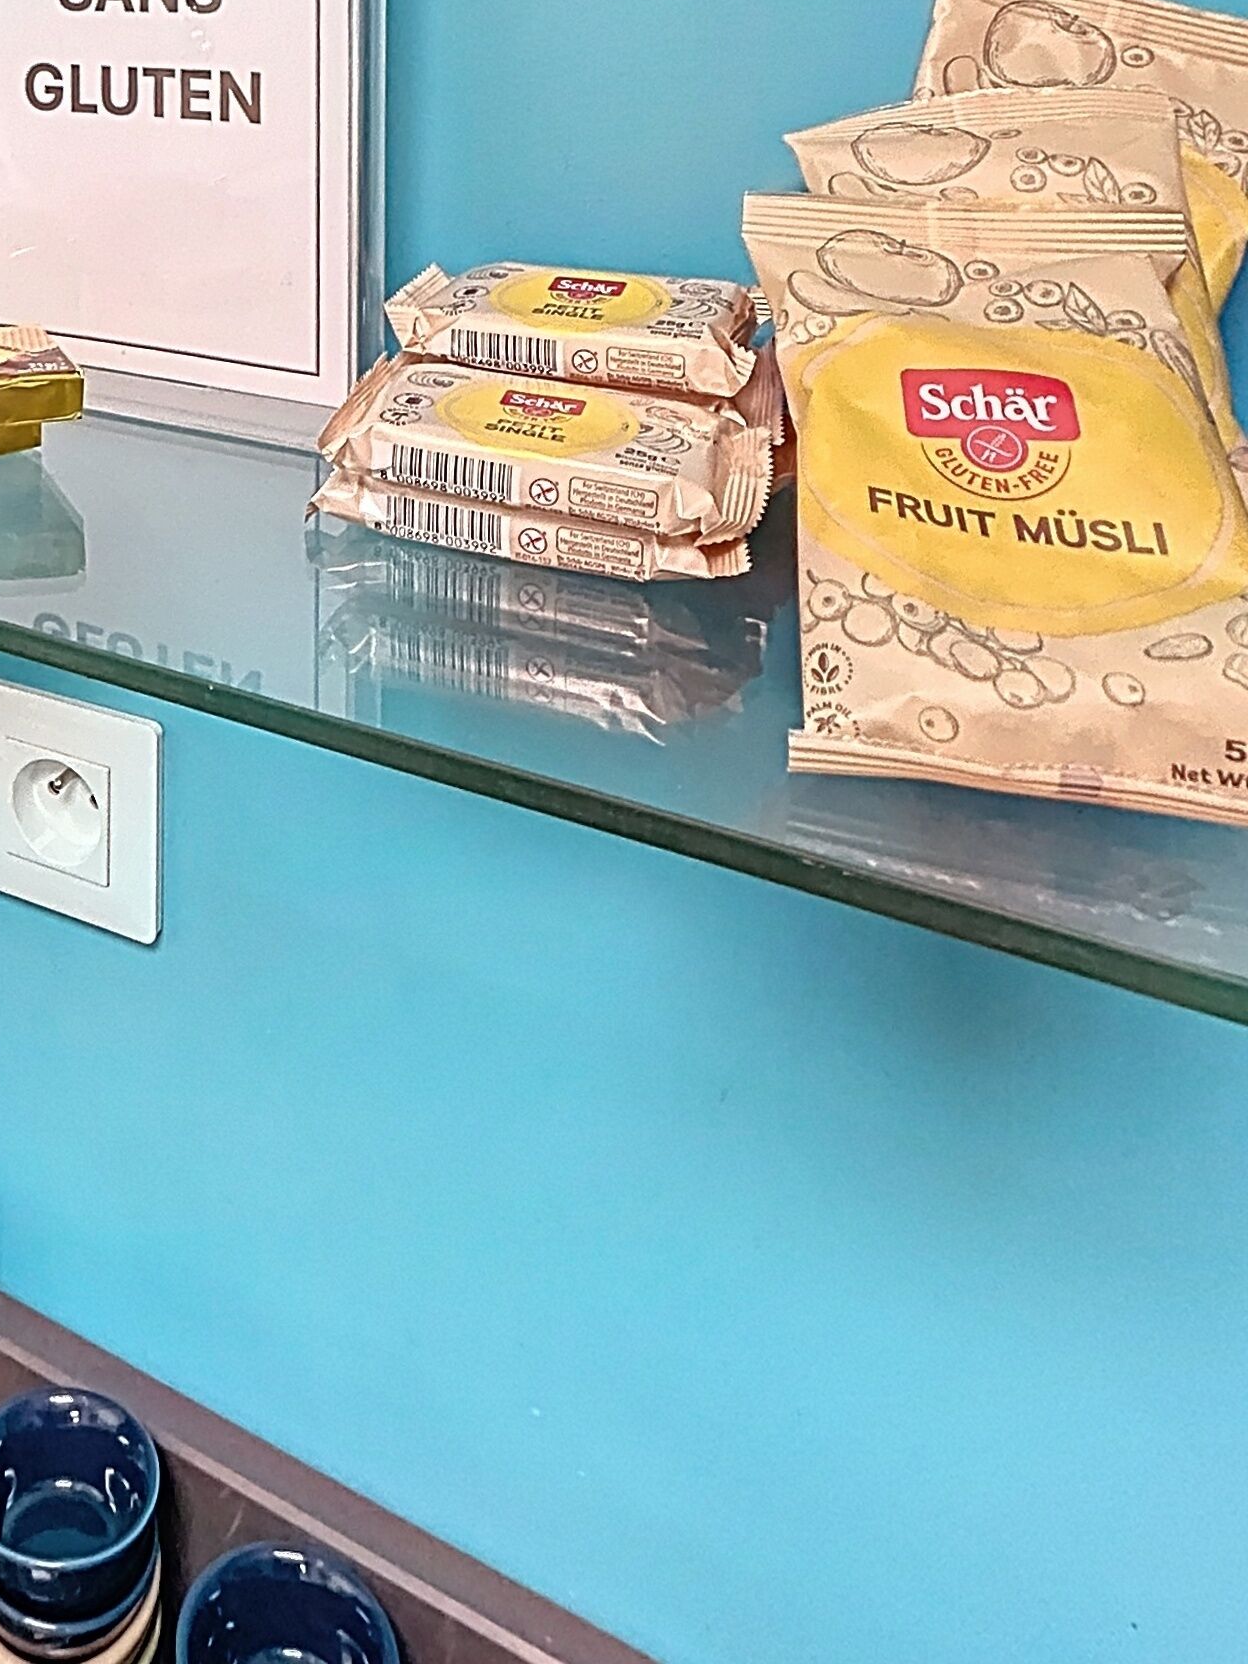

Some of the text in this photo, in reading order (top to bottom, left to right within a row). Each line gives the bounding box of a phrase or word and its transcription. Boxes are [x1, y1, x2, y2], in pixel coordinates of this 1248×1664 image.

[24, 62, 262, 125] GLUTEN
[531, 307, 605, 321] SINGLE
[543, 302, 603, 315] PETIT
[506, 361, 553, 375] 003992
[918, 382, 1058, 433] Schär
[484, 423, 567, 443] SINGLE
[496, 418, 563, 433] PETIT
[934, 446, 1060, 494] GLUTEN-FREE
[380, 469, 388, 480] 8
[454, 486, 506, 503] 003992
[867, 485, 1170, 556] FRUIT MÜSLI
[390, 525, 440, 544] 008698
[445, 536, 497, 555] 003992
[810, 683, 843, 696] FIBRE
[806, 701, 852, 720] PALM OIL
[1171, 762, 1248, 789] Net W
